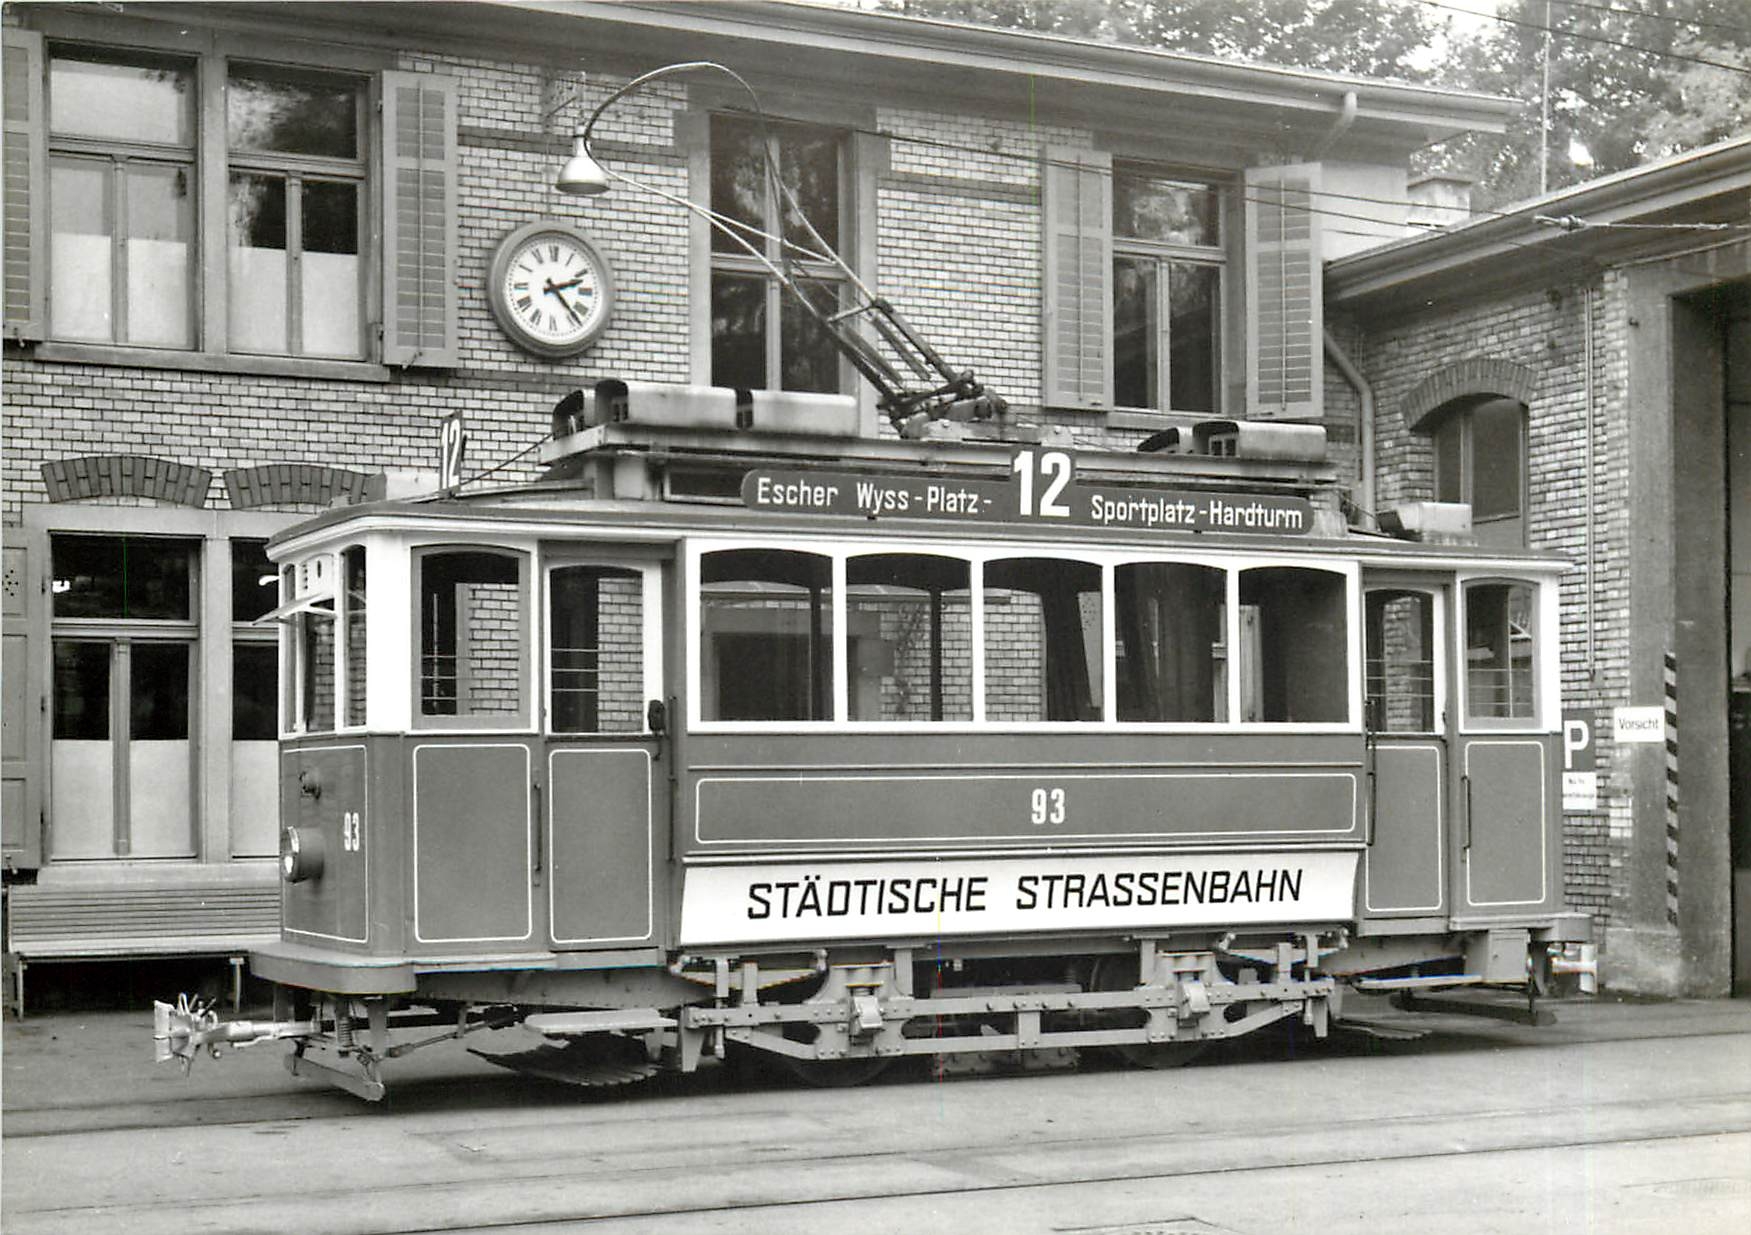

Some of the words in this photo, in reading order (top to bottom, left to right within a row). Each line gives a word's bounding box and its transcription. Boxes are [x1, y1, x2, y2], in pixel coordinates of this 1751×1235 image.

[441, 419, 460, 489] 12
[757, 477, 839, 507] Escher
[1013, 450, 1071, 517] 12
[1564, 720, 1590, 769] P
[1618, 718, 1659, 731] Vorsicht
[1031, 788, 1066, 825] 93
[344, 812, 360, 851] 93
[747, 875, 989, 920] STÄDTISCHE
[1016, 868, 1303, 910] STRASSENBAHN
